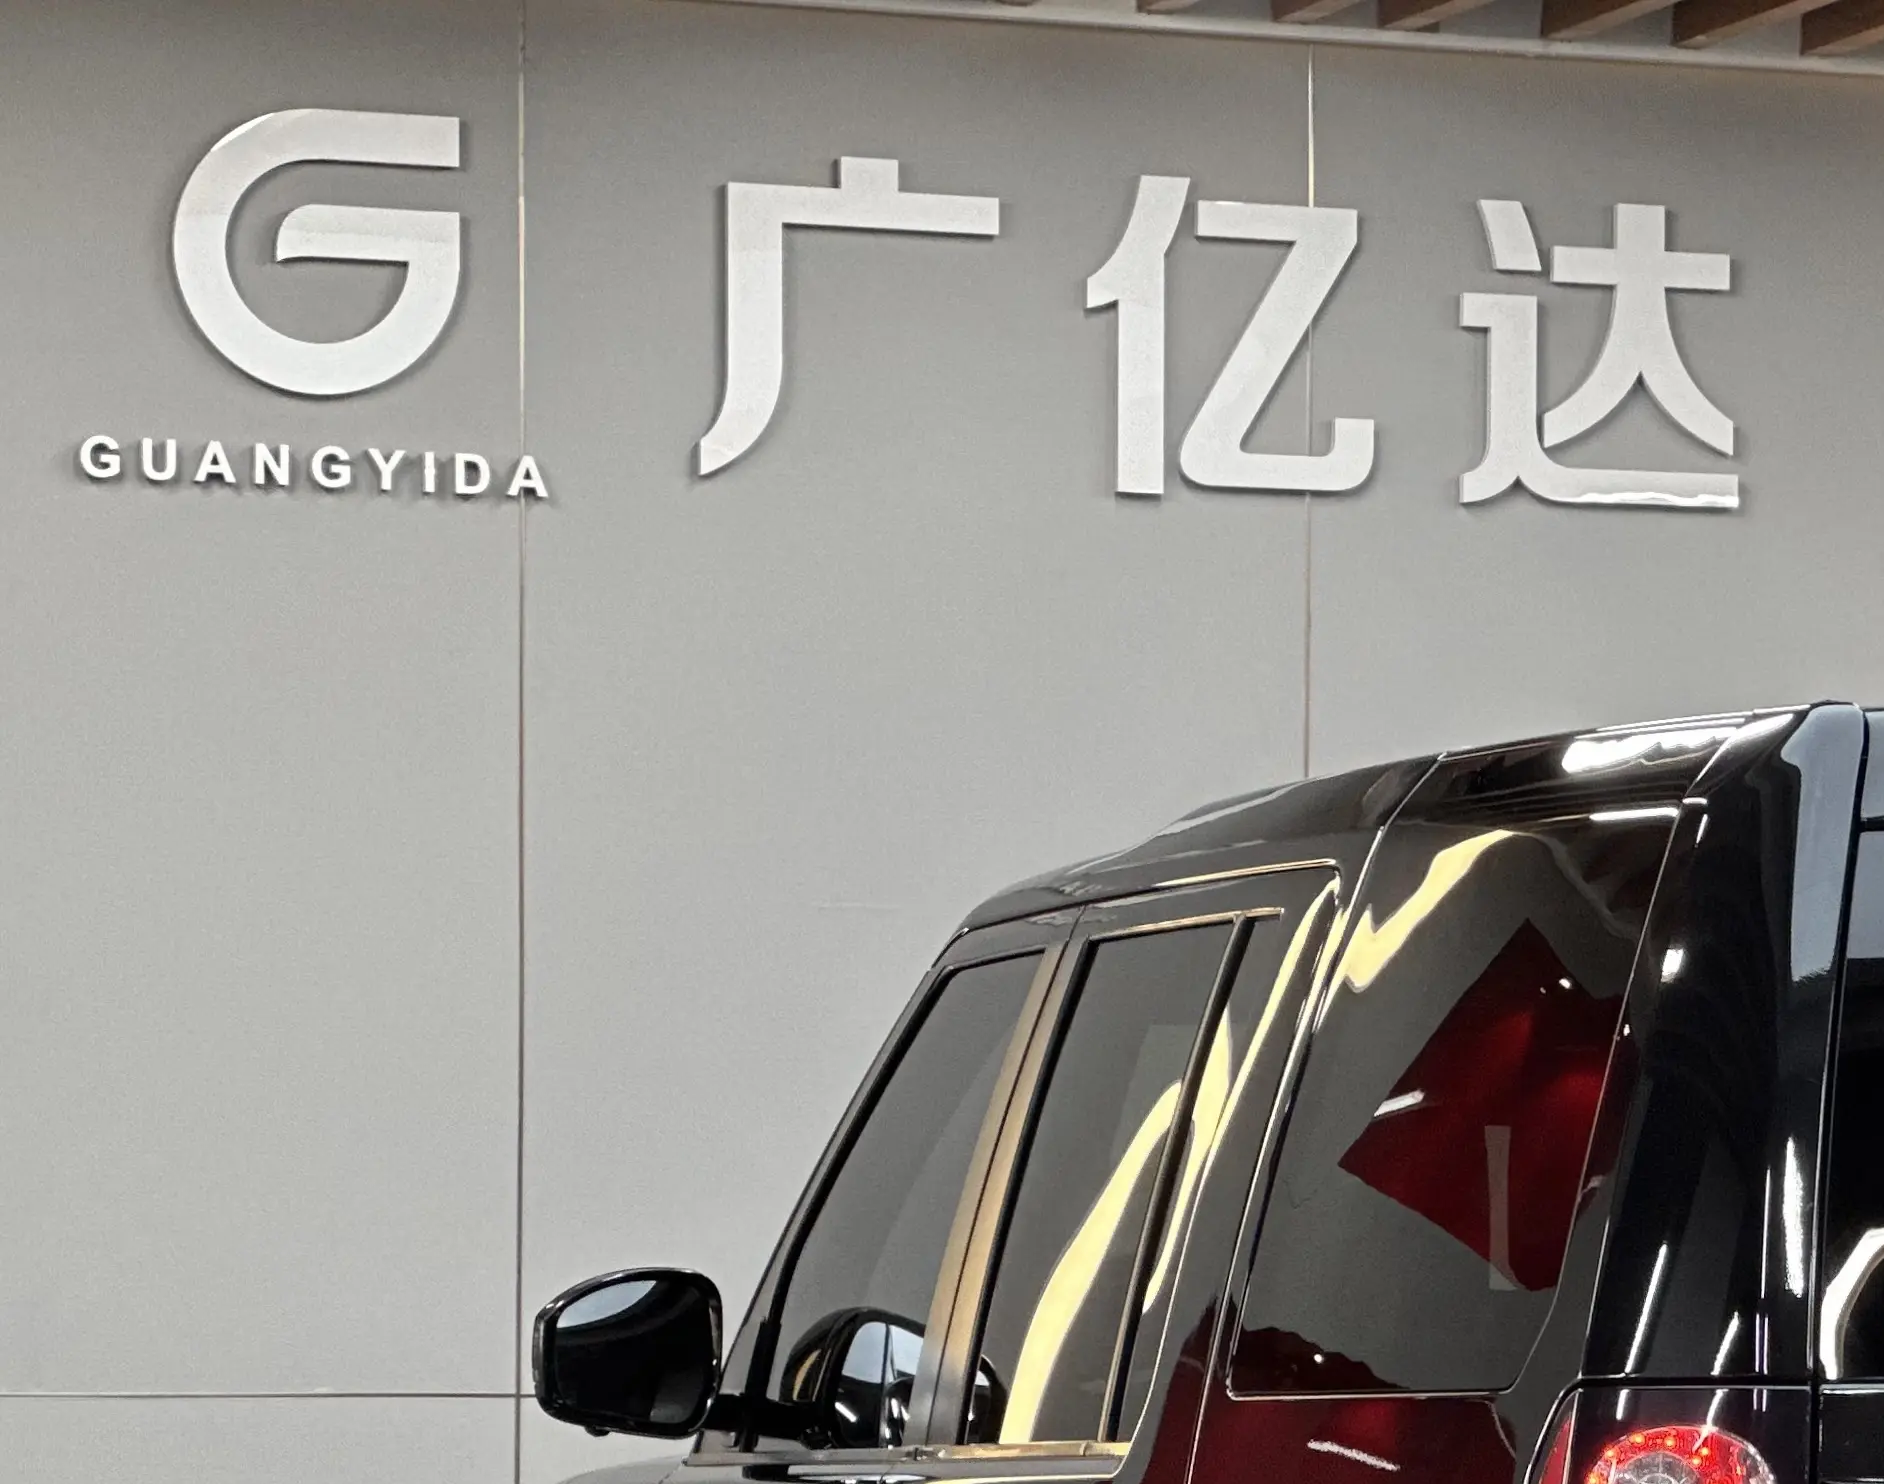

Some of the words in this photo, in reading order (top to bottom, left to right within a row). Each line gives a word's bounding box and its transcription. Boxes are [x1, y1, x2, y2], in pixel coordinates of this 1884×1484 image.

[697, 156, 1740, 509] 广亿达
[79, 434, 549, 499] GUANGYIDA
